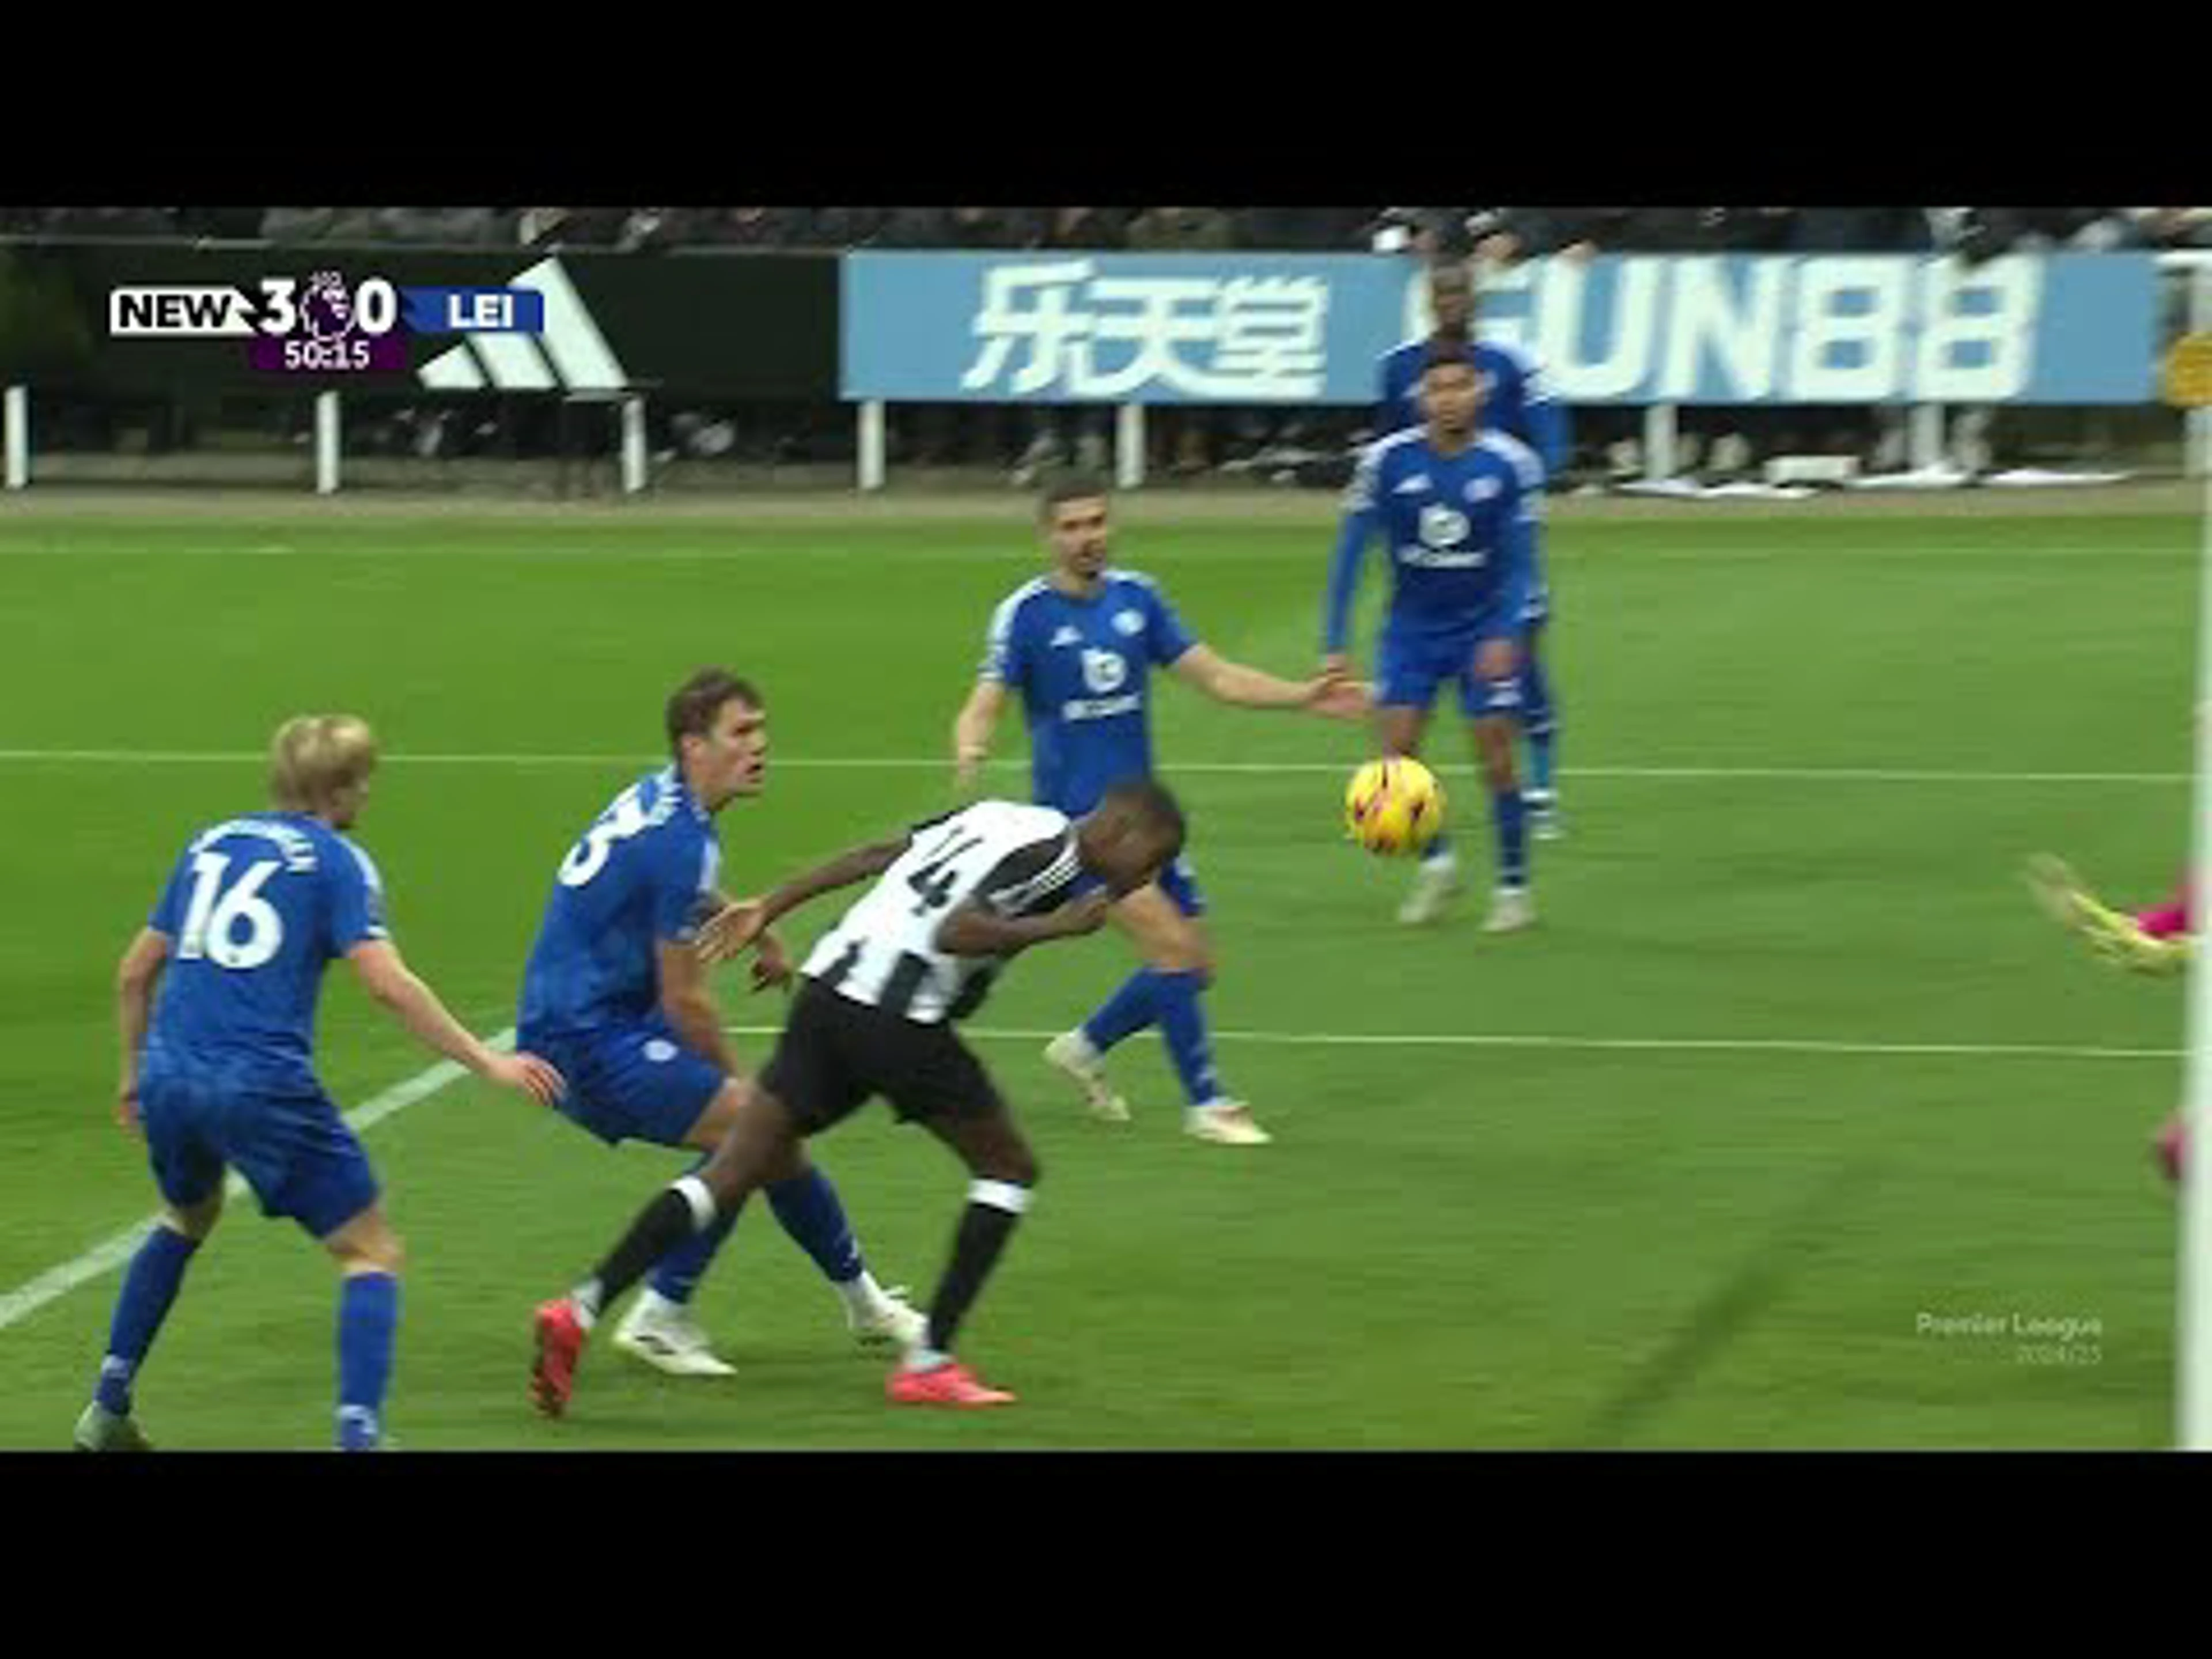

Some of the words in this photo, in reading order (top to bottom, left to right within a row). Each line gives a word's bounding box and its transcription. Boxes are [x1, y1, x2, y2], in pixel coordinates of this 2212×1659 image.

[959, 260, 1327, 398] 乐天堂
[177, 851, 285, 969] 16
